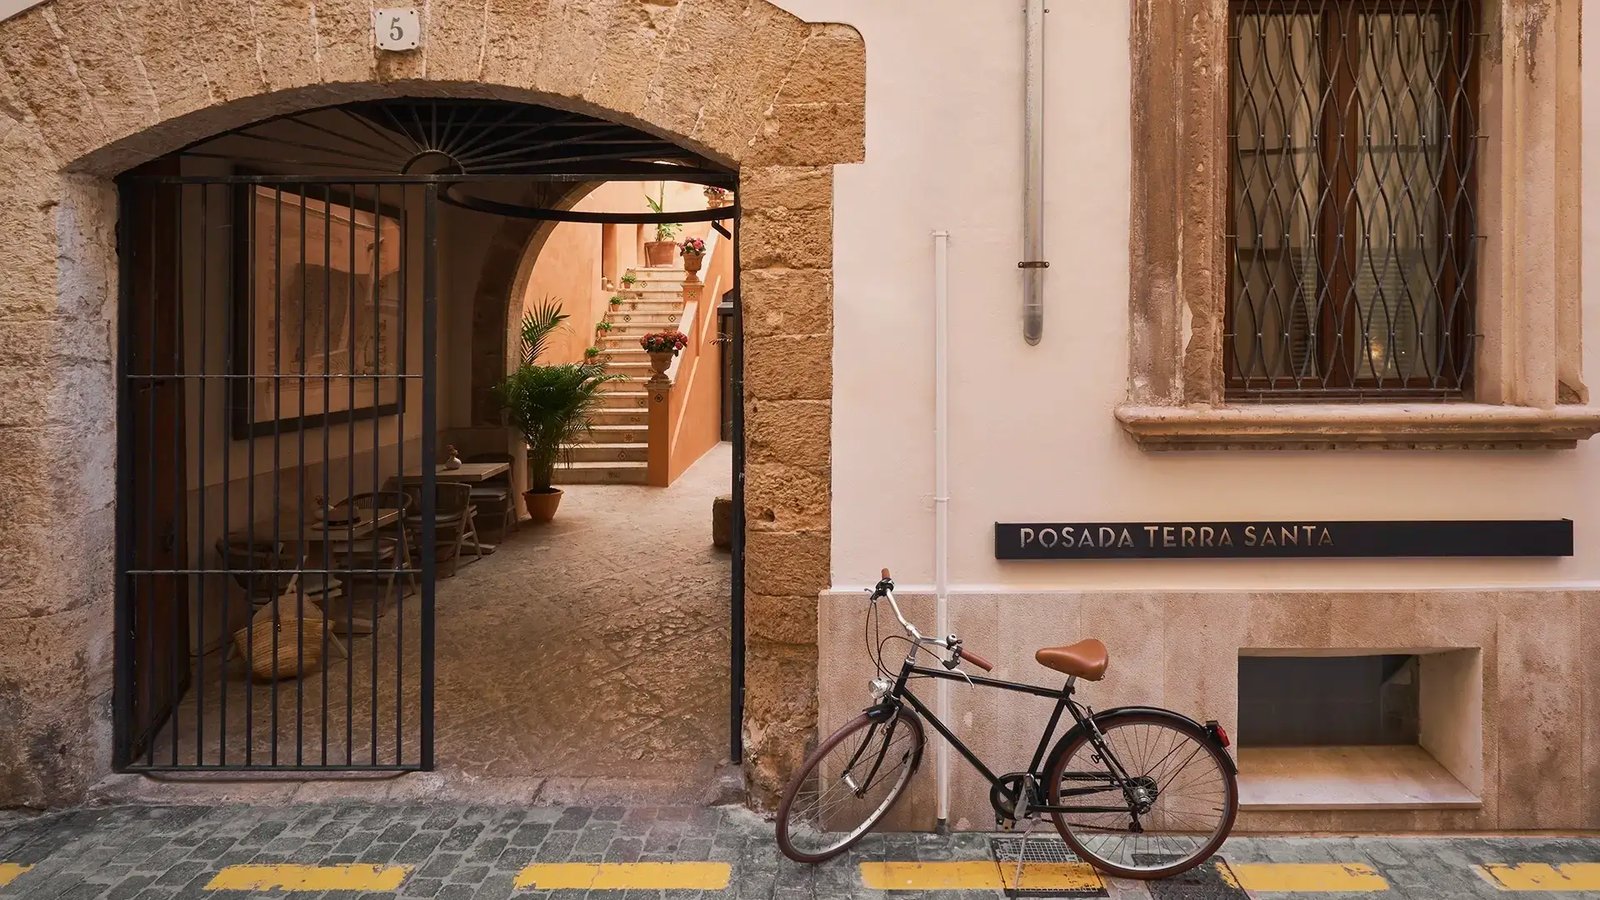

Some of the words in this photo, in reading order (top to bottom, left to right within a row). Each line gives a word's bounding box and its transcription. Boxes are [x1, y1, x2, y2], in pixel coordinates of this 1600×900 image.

[389, 17, 404, 41] 5
[1020, 527, 1135, 548] POSADA
[1144, 526, 1234, 548] TERRA
[1244, 525, 1335, 547] SANTA
